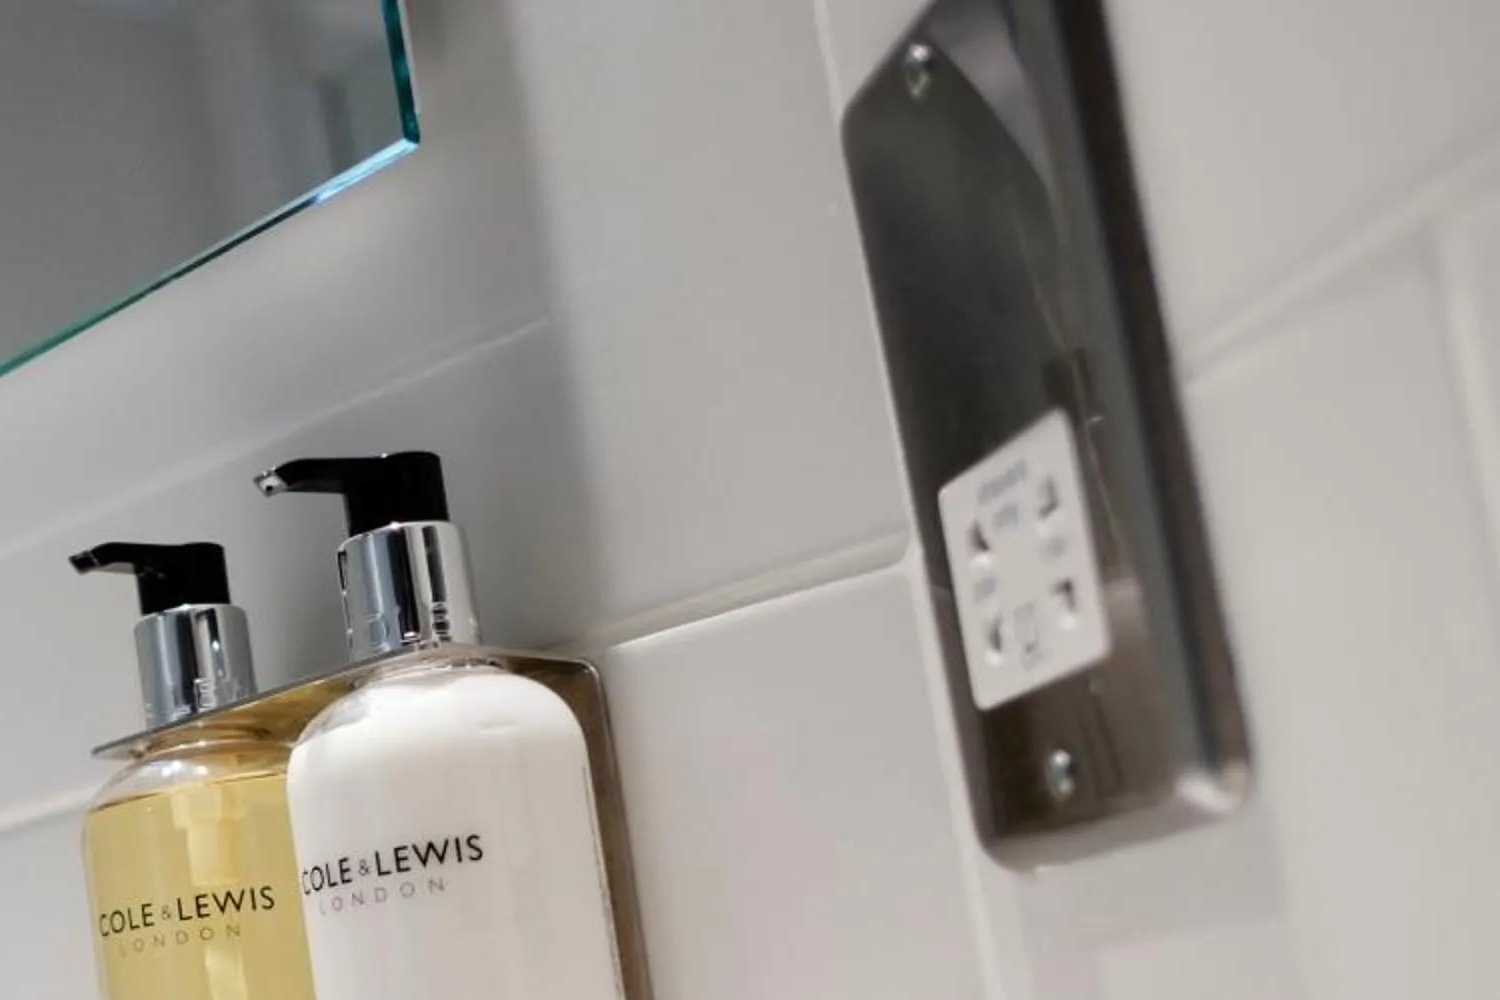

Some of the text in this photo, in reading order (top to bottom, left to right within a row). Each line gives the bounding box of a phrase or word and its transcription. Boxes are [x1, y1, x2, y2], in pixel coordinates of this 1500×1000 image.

[302, 834, 484, 896] COLE & LEWIS
[99, 885, 276, 938] COLE & LEWIS
[319, 877, 446, 917] LONDON
[118, 923, 241, 959] LONDON
